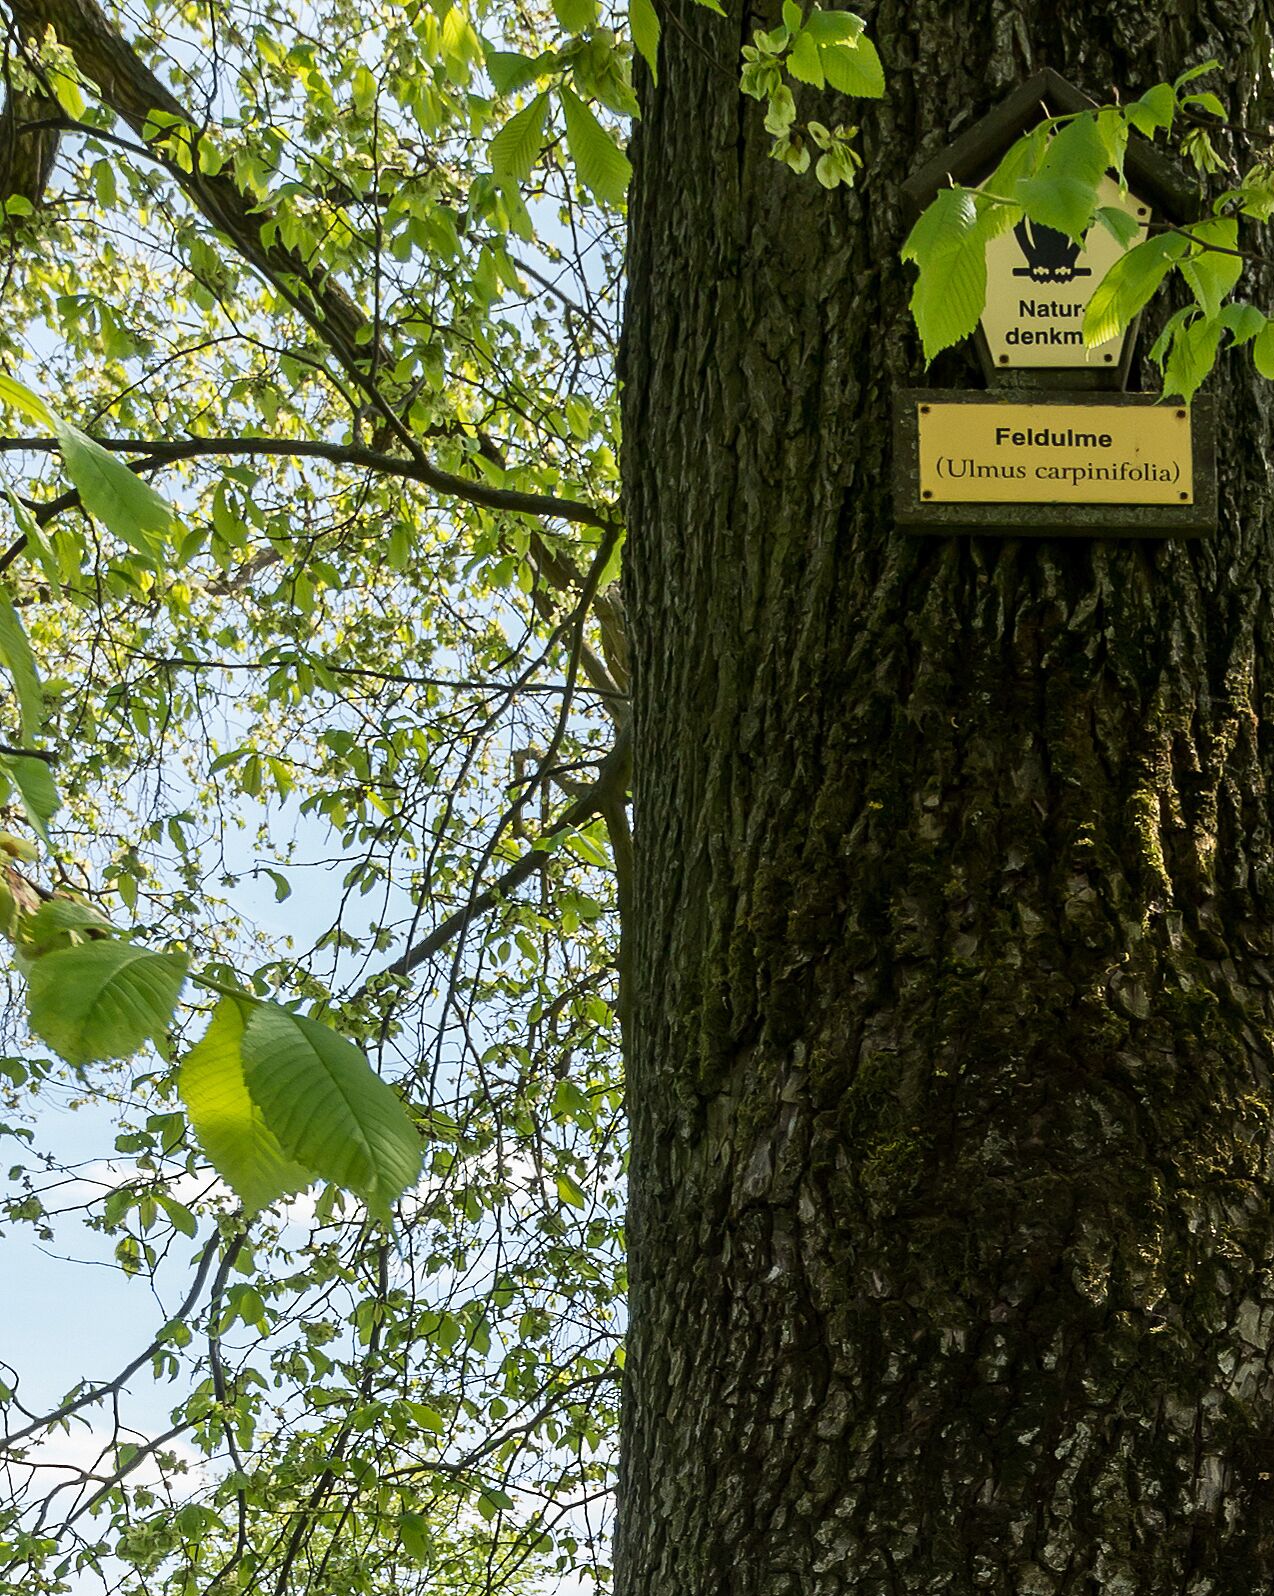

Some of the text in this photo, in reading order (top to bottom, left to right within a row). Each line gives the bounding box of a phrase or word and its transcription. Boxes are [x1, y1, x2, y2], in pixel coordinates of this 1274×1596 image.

[1005, 327, 1084, 345] denkm
[995, 427, 1113, 448] Feldulme
[936, 456, 1180, 486] (Ulmus carpinifolia)
